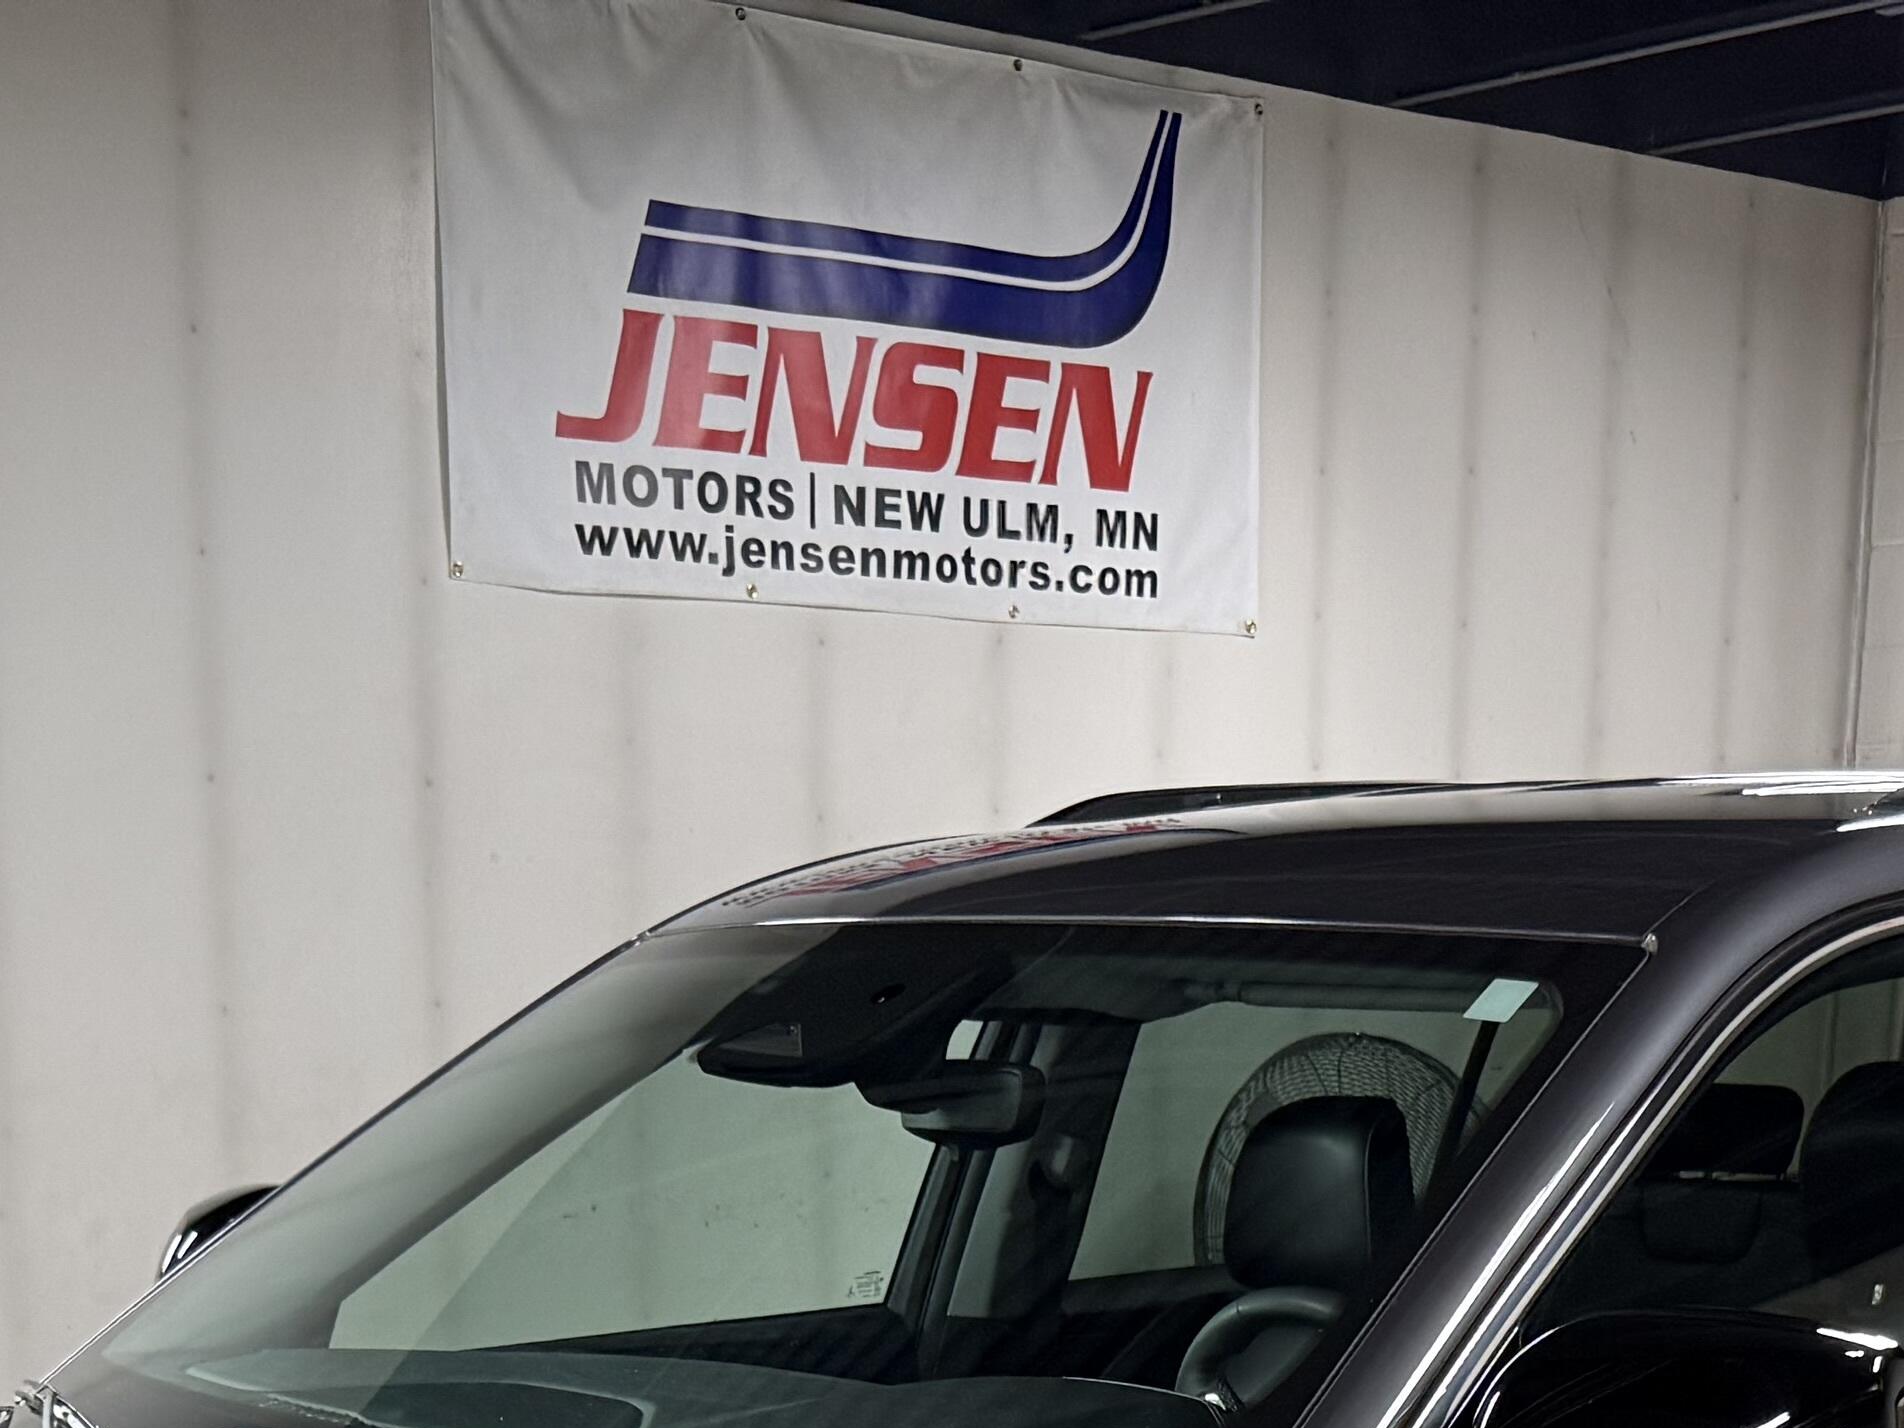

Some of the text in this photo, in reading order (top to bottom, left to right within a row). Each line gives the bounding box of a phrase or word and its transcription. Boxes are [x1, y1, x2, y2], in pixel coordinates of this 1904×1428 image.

[555, 308, 1154, 492] JENSEN
[575, 460, 1160, 552] MOTORS NEW ULM, MN
[575, 523, 1159, 599] www.jensenmotors.com
